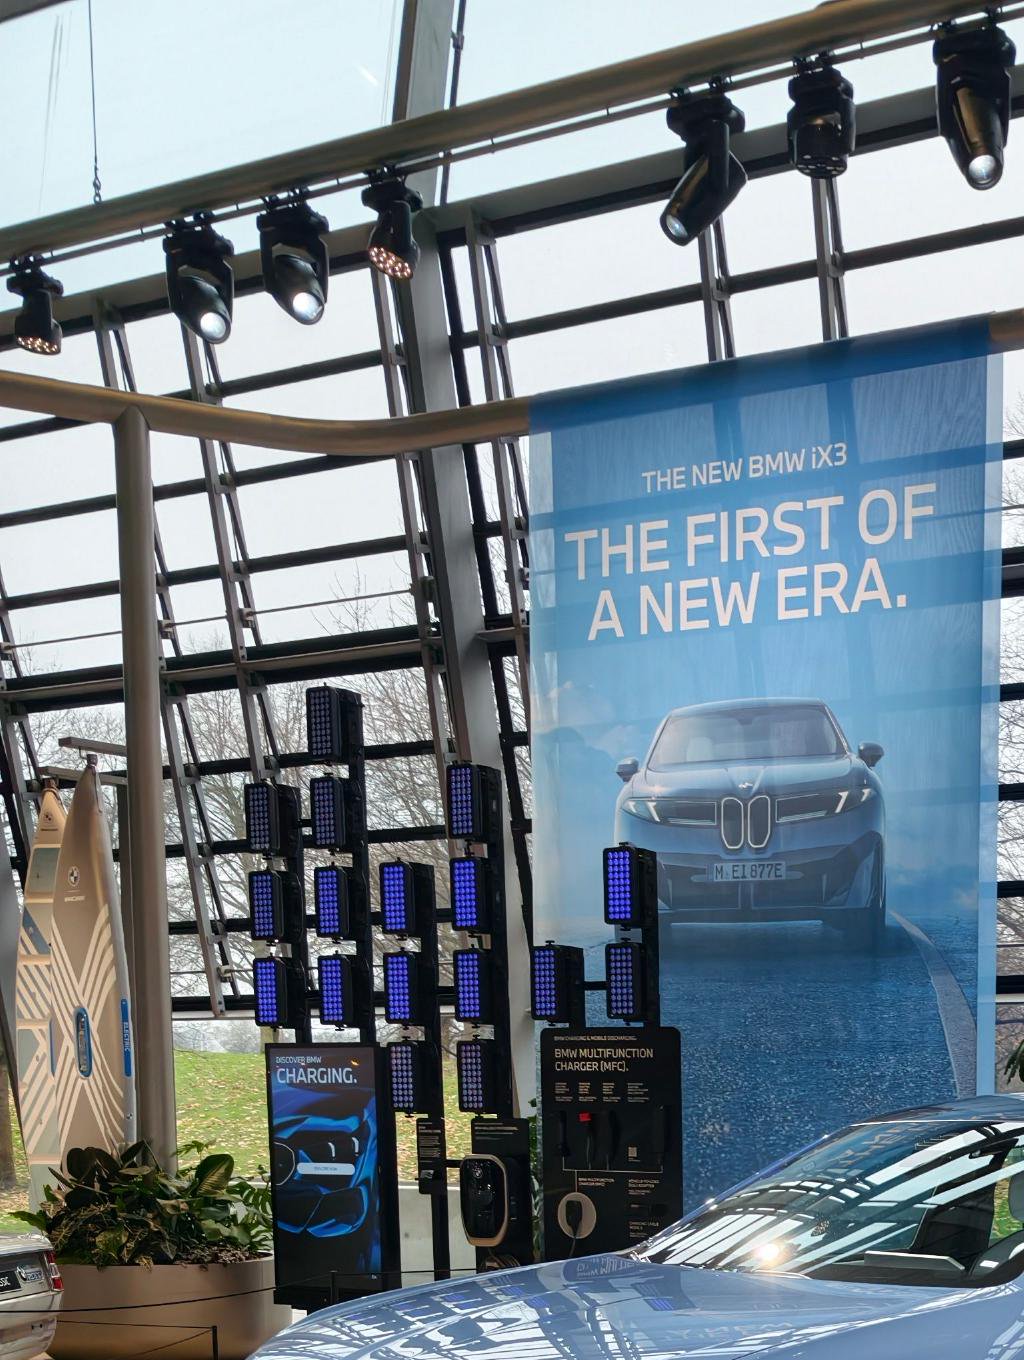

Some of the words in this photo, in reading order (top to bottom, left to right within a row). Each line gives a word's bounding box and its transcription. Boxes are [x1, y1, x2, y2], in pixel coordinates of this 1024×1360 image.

[641, 467, 686, 494] THE
[691, 460, 743, 486] NEW
[748, 448, 807, 475] BMW
[811, 442, 848, 469] iX3
[564, 519, 670, 581] THE
[686, 495, 844, 567] FIRST
[858, 483, 937, 545] OF
[587, 590, 624, 641] A
[640, 571, 760, 635] NEW
[777, 557, 907, 621] ERA.
[276, 1056, 306, 1064] DISCOVER
[306, 1056, 322, 1064] BMW
[554, 1048, 578, 1058] BMW
[579, 1048, 654, 1058] MULTIFUNCTION
[276, 1067, 357, 1084] CHARGING.
[555, 1061, 599, 1071] CHARGER
[600, 1061, 629, 1073] (MFC).
